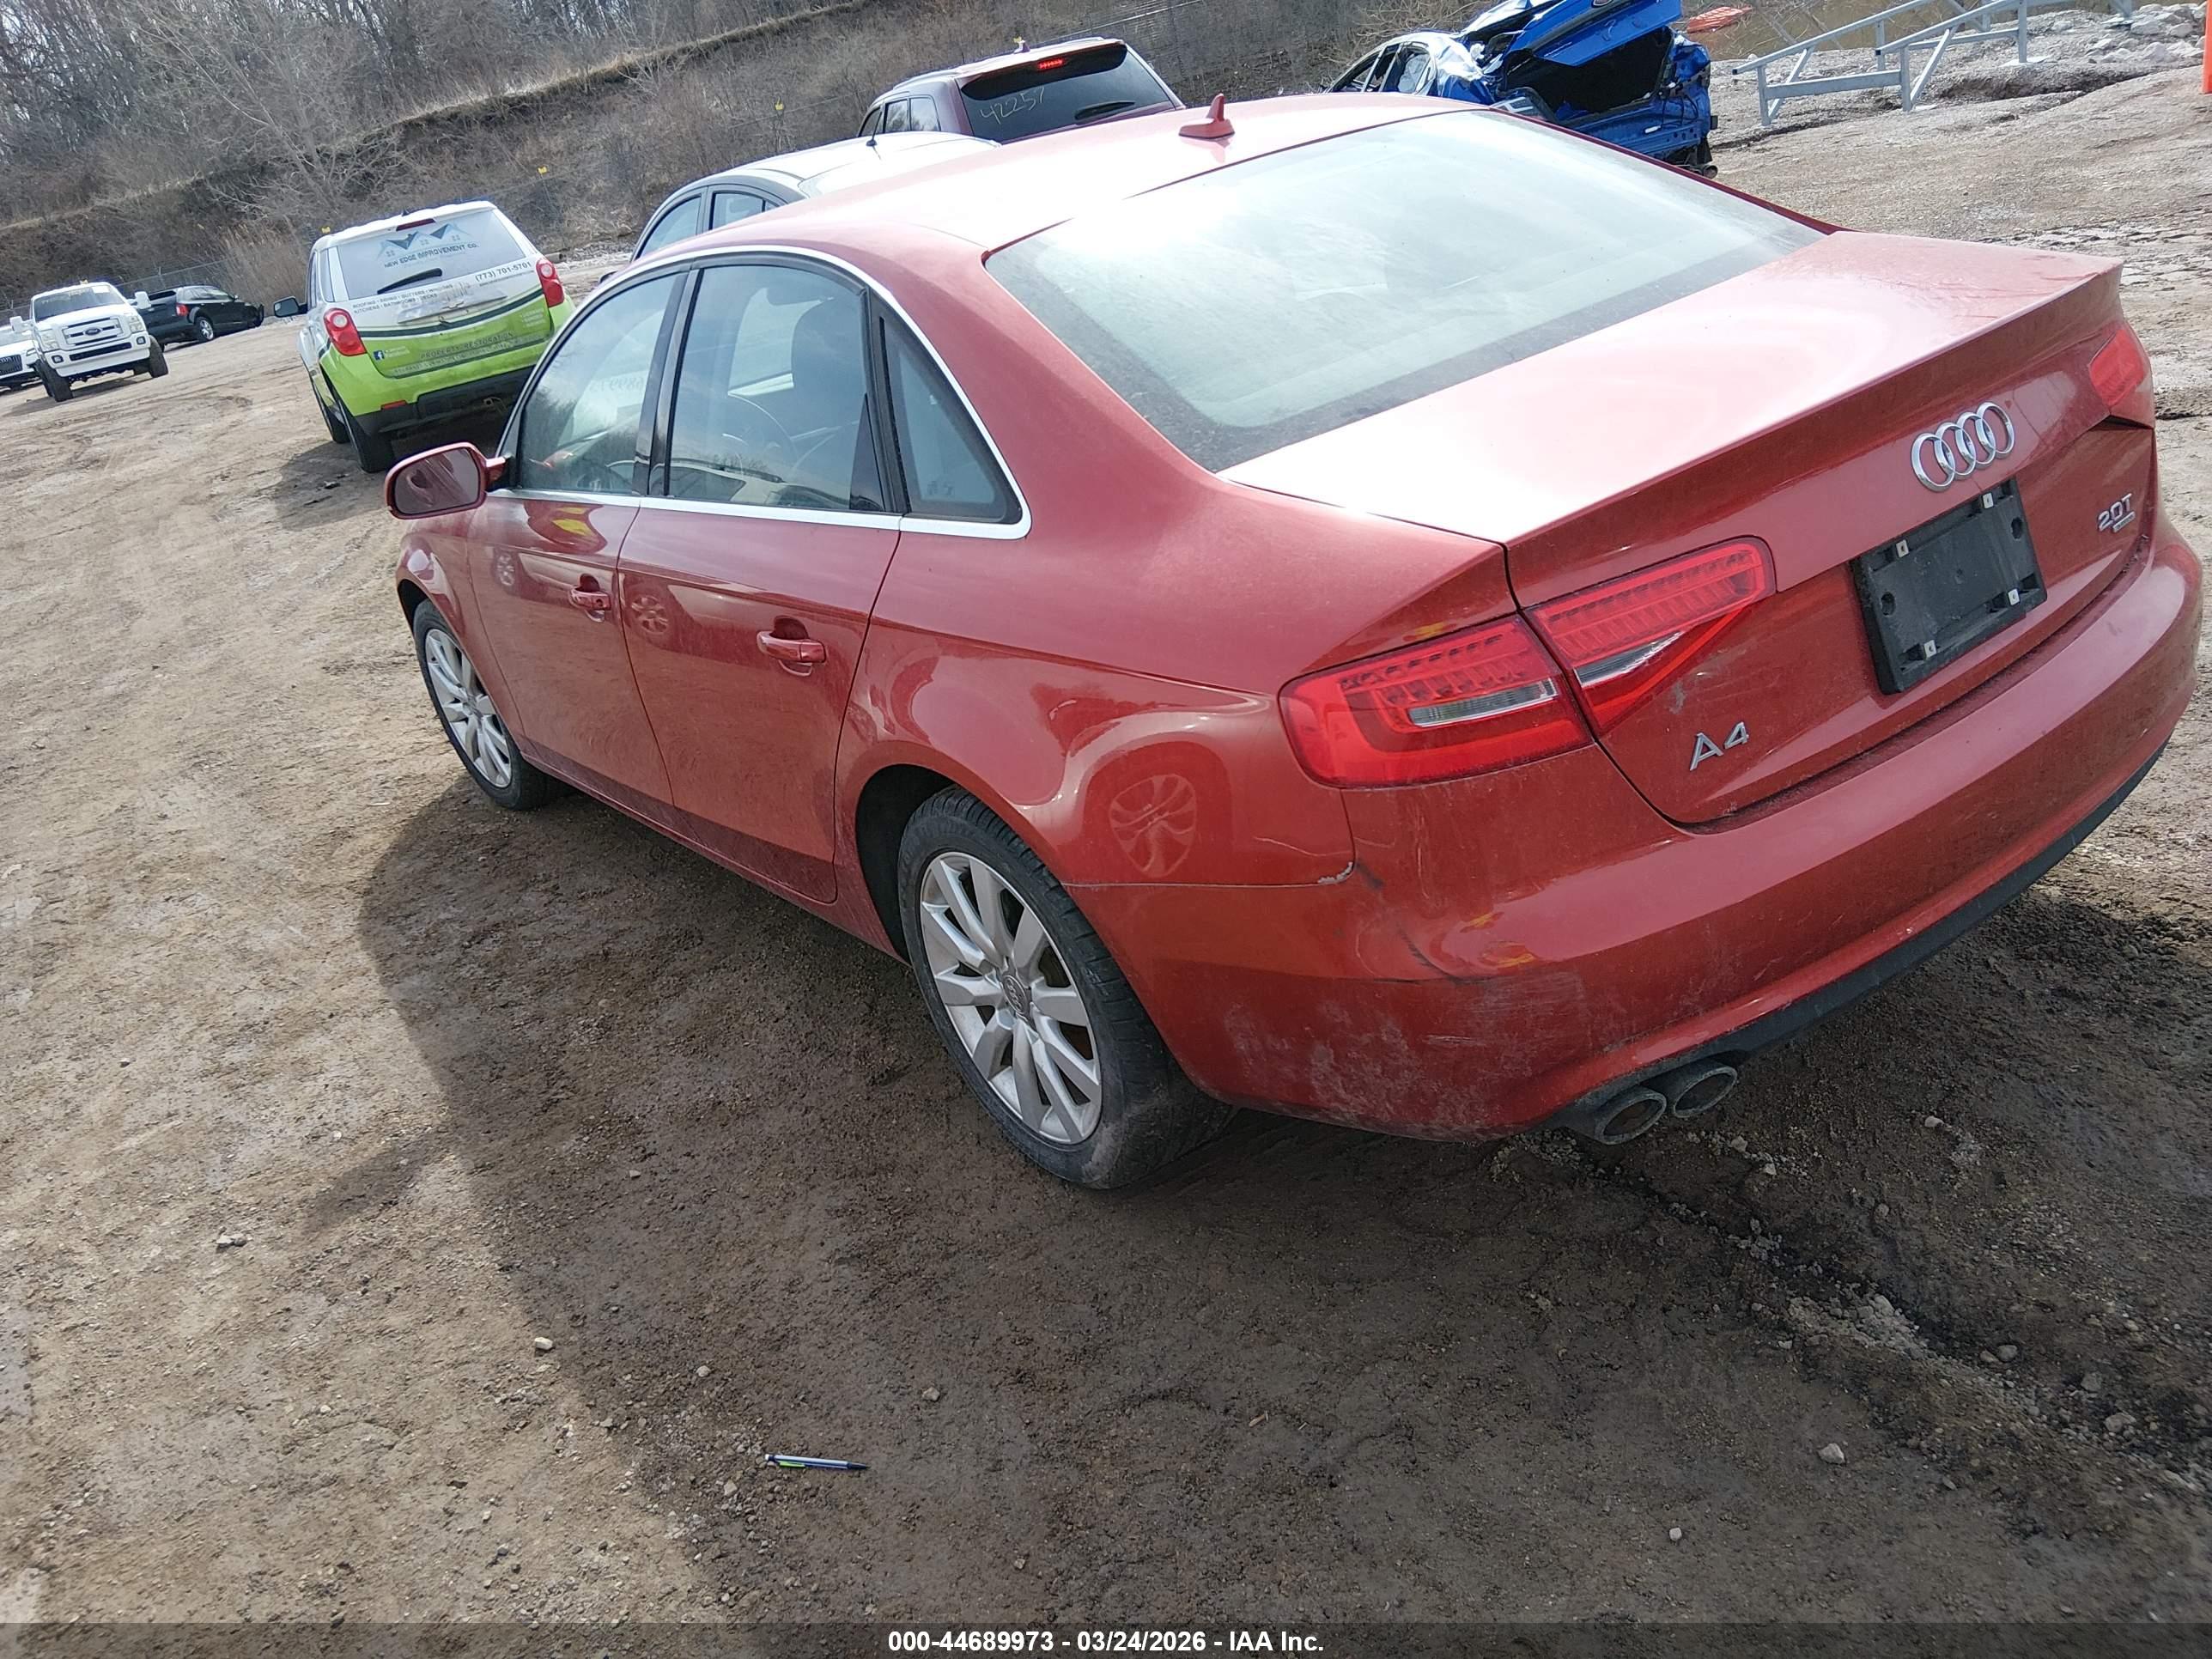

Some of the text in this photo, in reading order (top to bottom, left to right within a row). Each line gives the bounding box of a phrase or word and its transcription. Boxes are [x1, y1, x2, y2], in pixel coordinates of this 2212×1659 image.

[980, 86, 1044, 125] 42257
[384, 259, 399, 269] NEW
[398, 254, 417, 264] EDGE
[417, 244, 465, 259] IMPROVEMENT
[475, 270, 496, 282] (773)
[496, 261, 532, 275] 701-5701
[1689, 721, 1749, 771] A4
